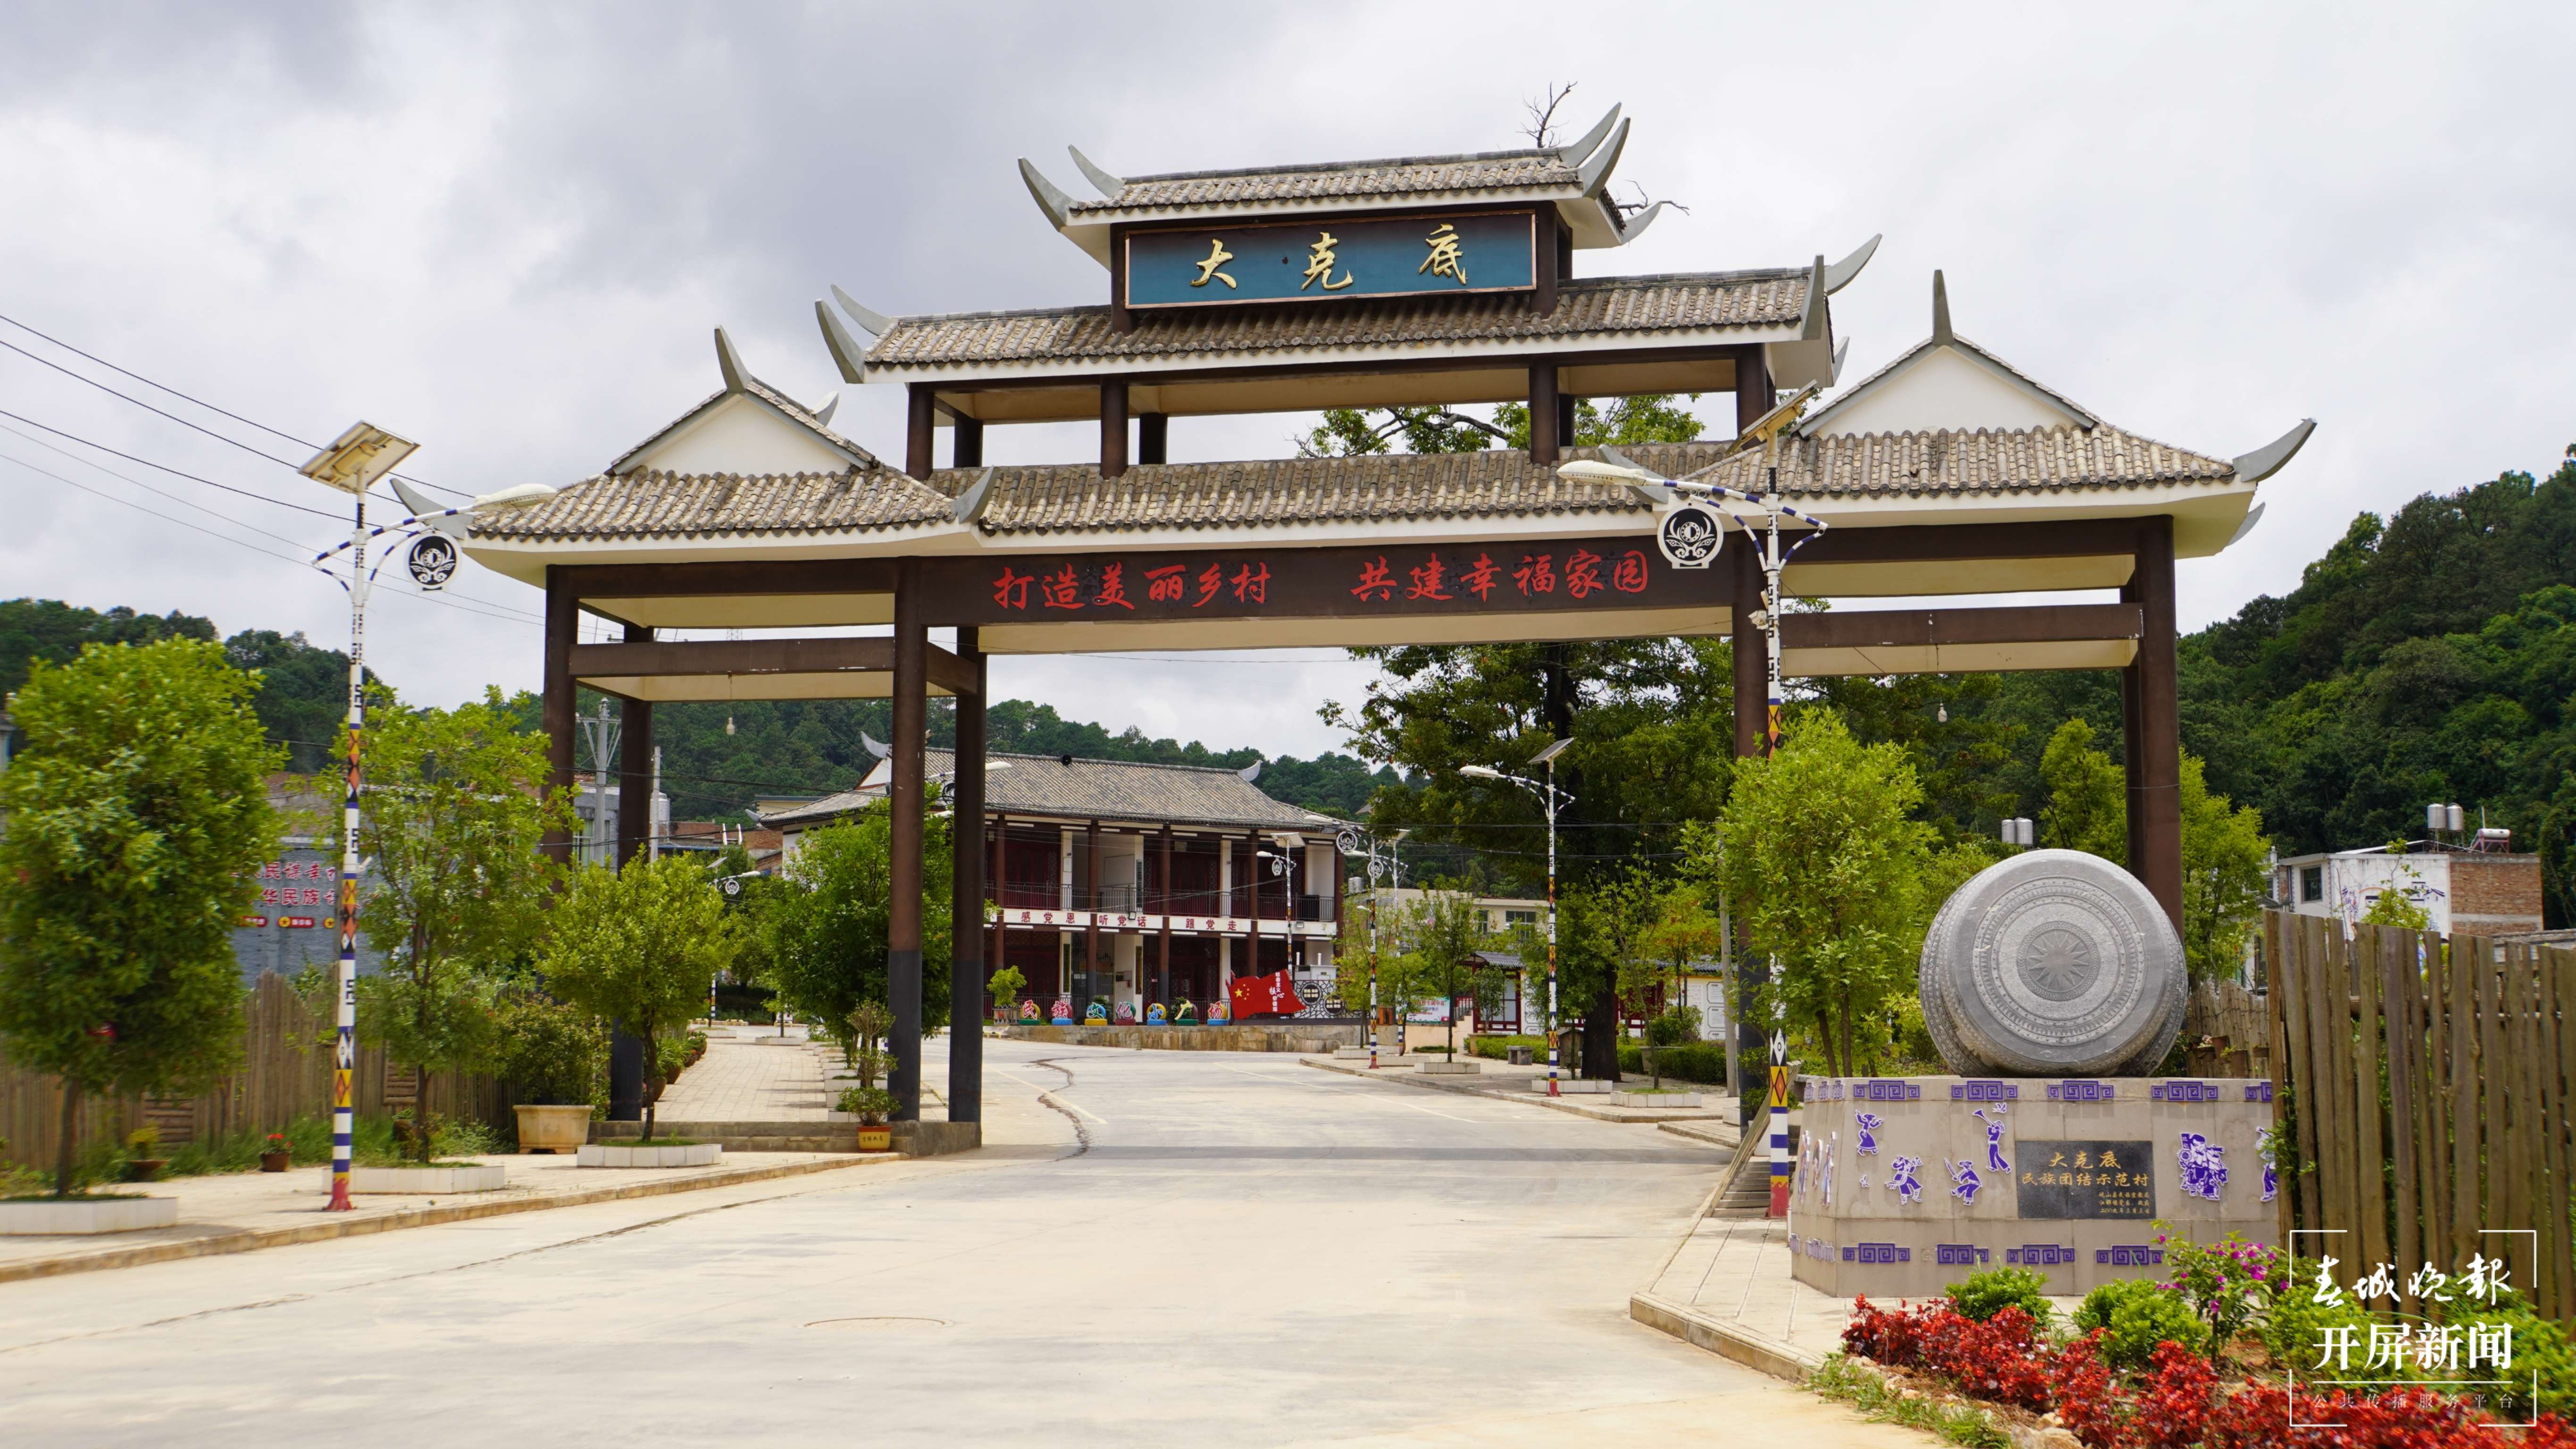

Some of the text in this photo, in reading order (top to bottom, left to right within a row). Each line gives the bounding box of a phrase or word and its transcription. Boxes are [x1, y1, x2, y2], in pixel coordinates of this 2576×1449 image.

[1190, 223, 1468, 291] 大克底
[992, 561, 1271, 610] 打造美丽乡村
[1350, 549, 1648, 603] 共建幸福家园
[1021, 911, 1075, 924] 感党恩
[1099, 914, 1146, 927] 听党话
[1186, 918, 1237, 931] 跟党走
[1022, 999, 1223, 1020] 民族文化小广场
[2049, 1150, 2121, 1169] 大克底
[2022, 1172, 2149, 1187] 民族团结示范村
